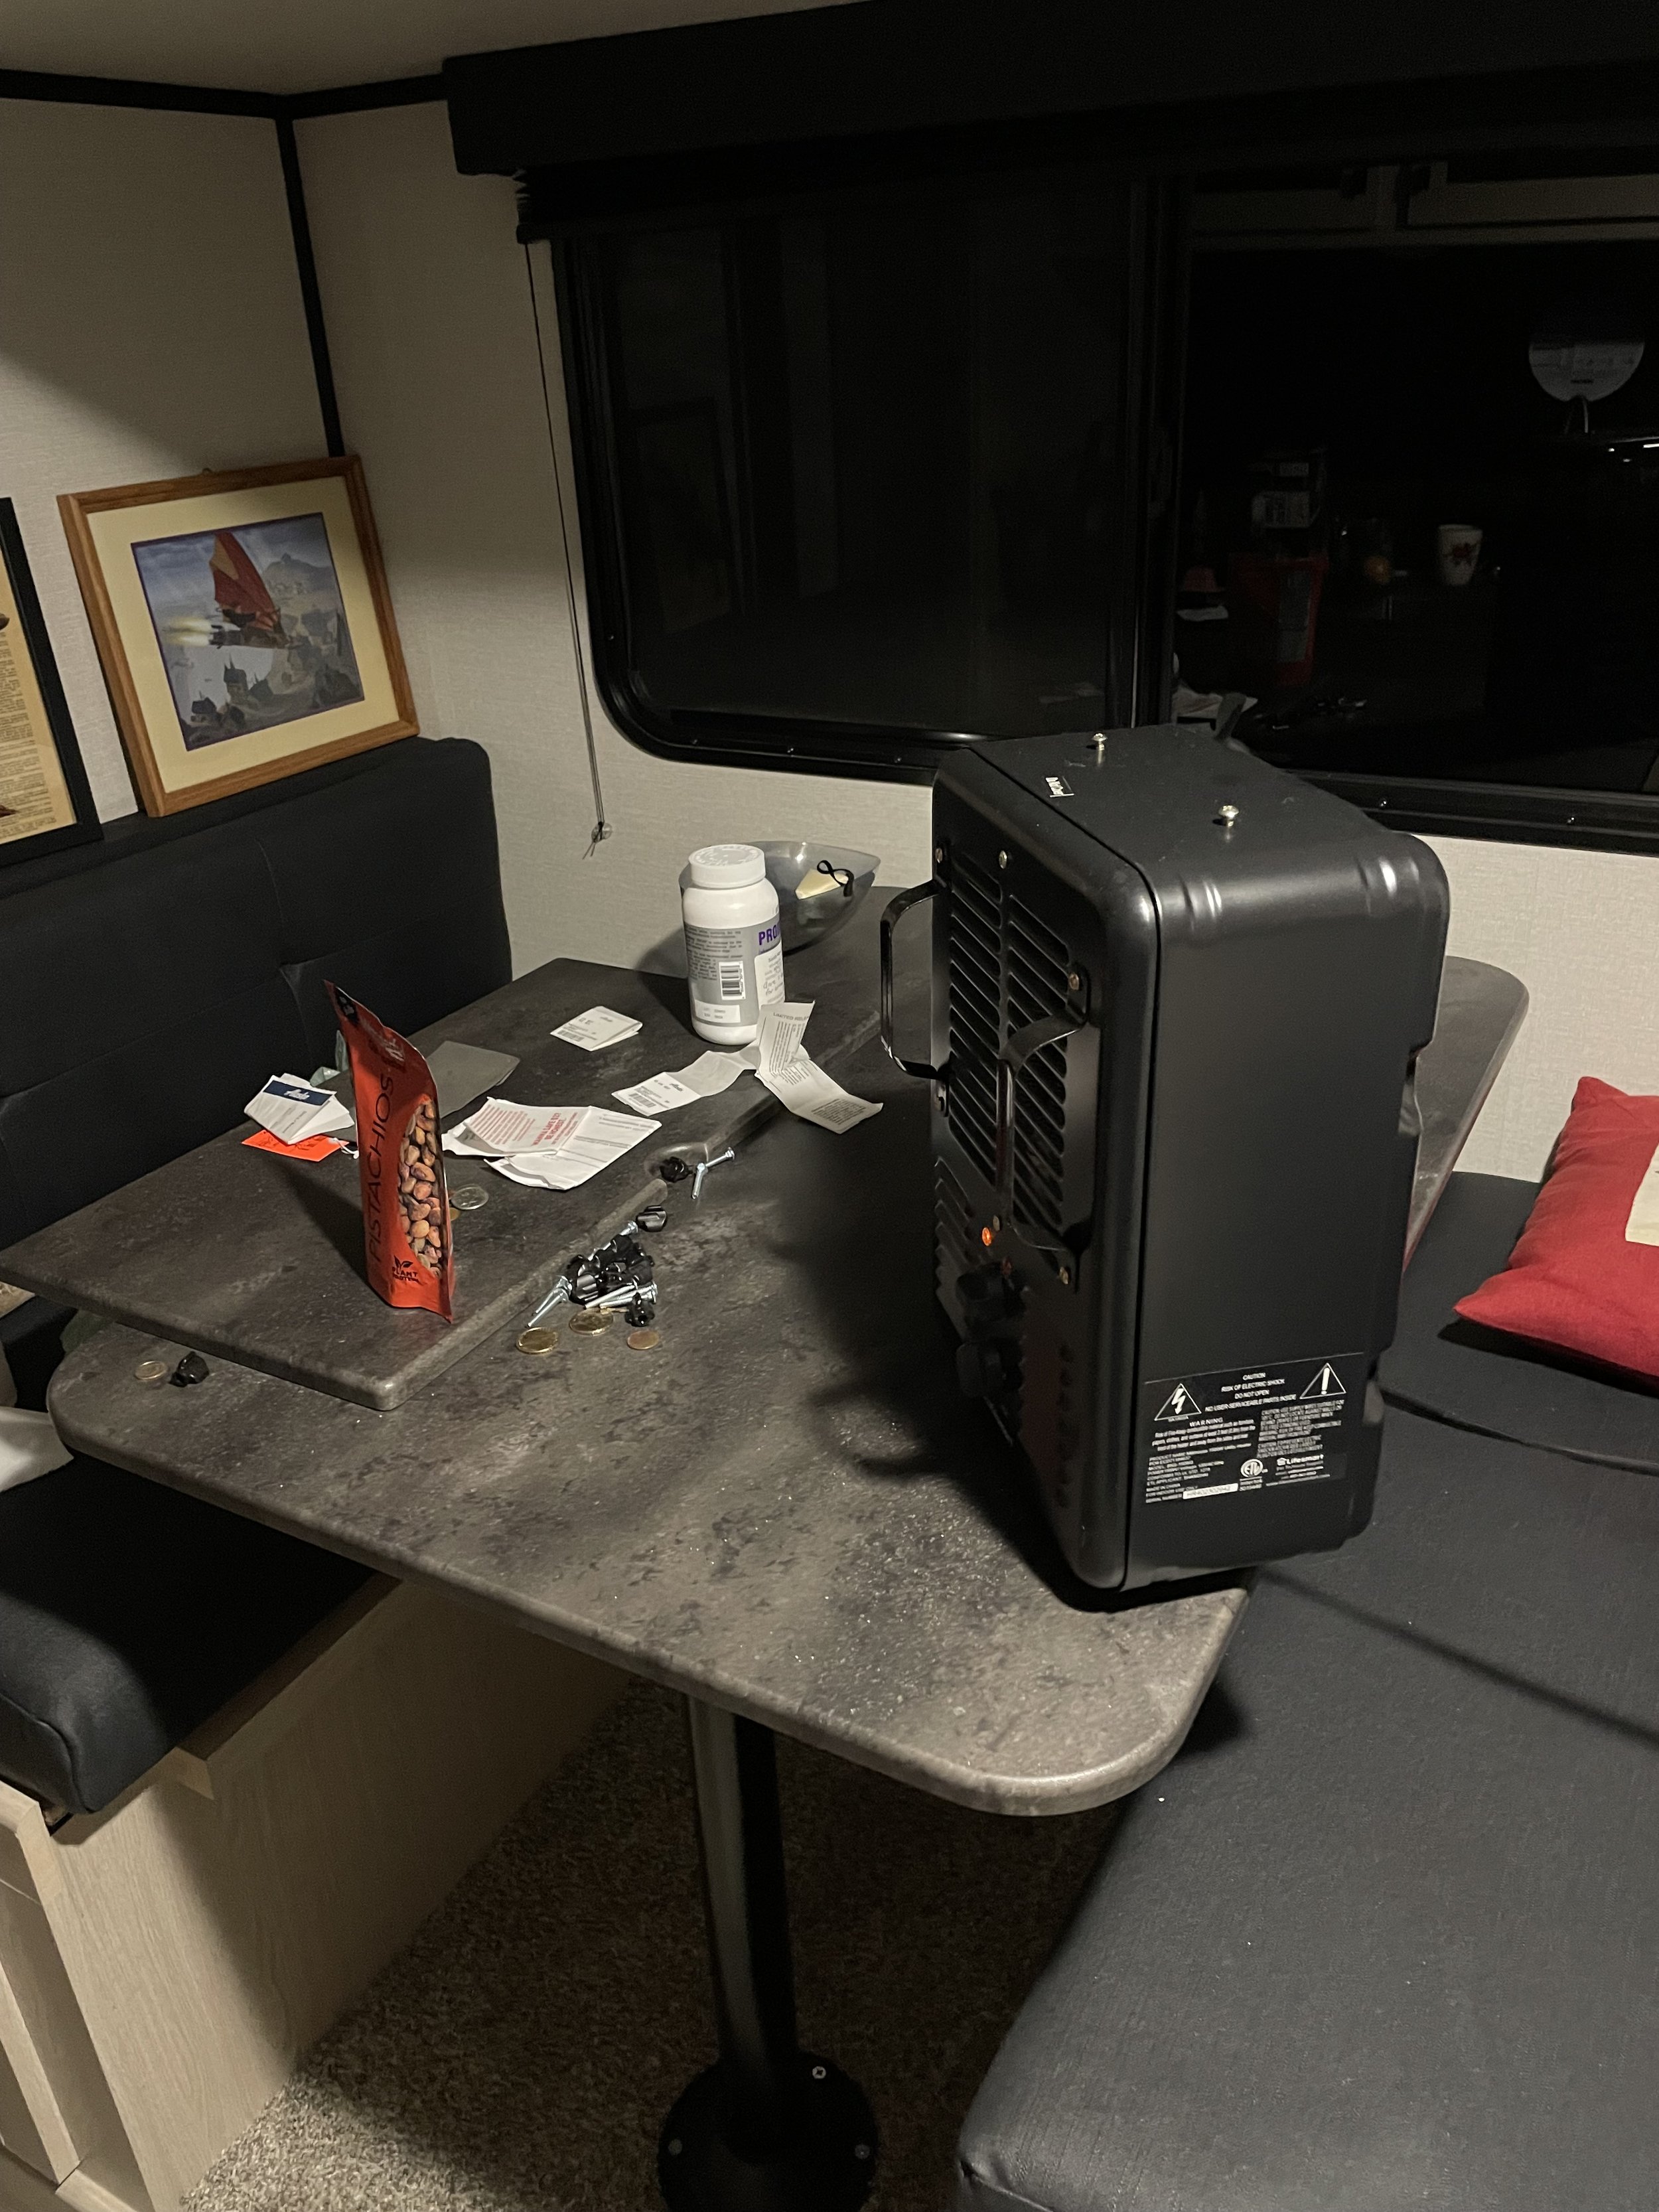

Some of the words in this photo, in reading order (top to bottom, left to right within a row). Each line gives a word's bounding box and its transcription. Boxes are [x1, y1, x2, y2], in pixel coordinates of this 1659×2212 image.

[758, 924, 779, 946] PRO
[368, 1072, 394, 1261] PISTACHIOS
[392, 1266, 417, 1277] PLANT
[1242, 1381, 1267, 1390] ELECTRIC
[1189, 1417, 1224, 1427] WARNING
